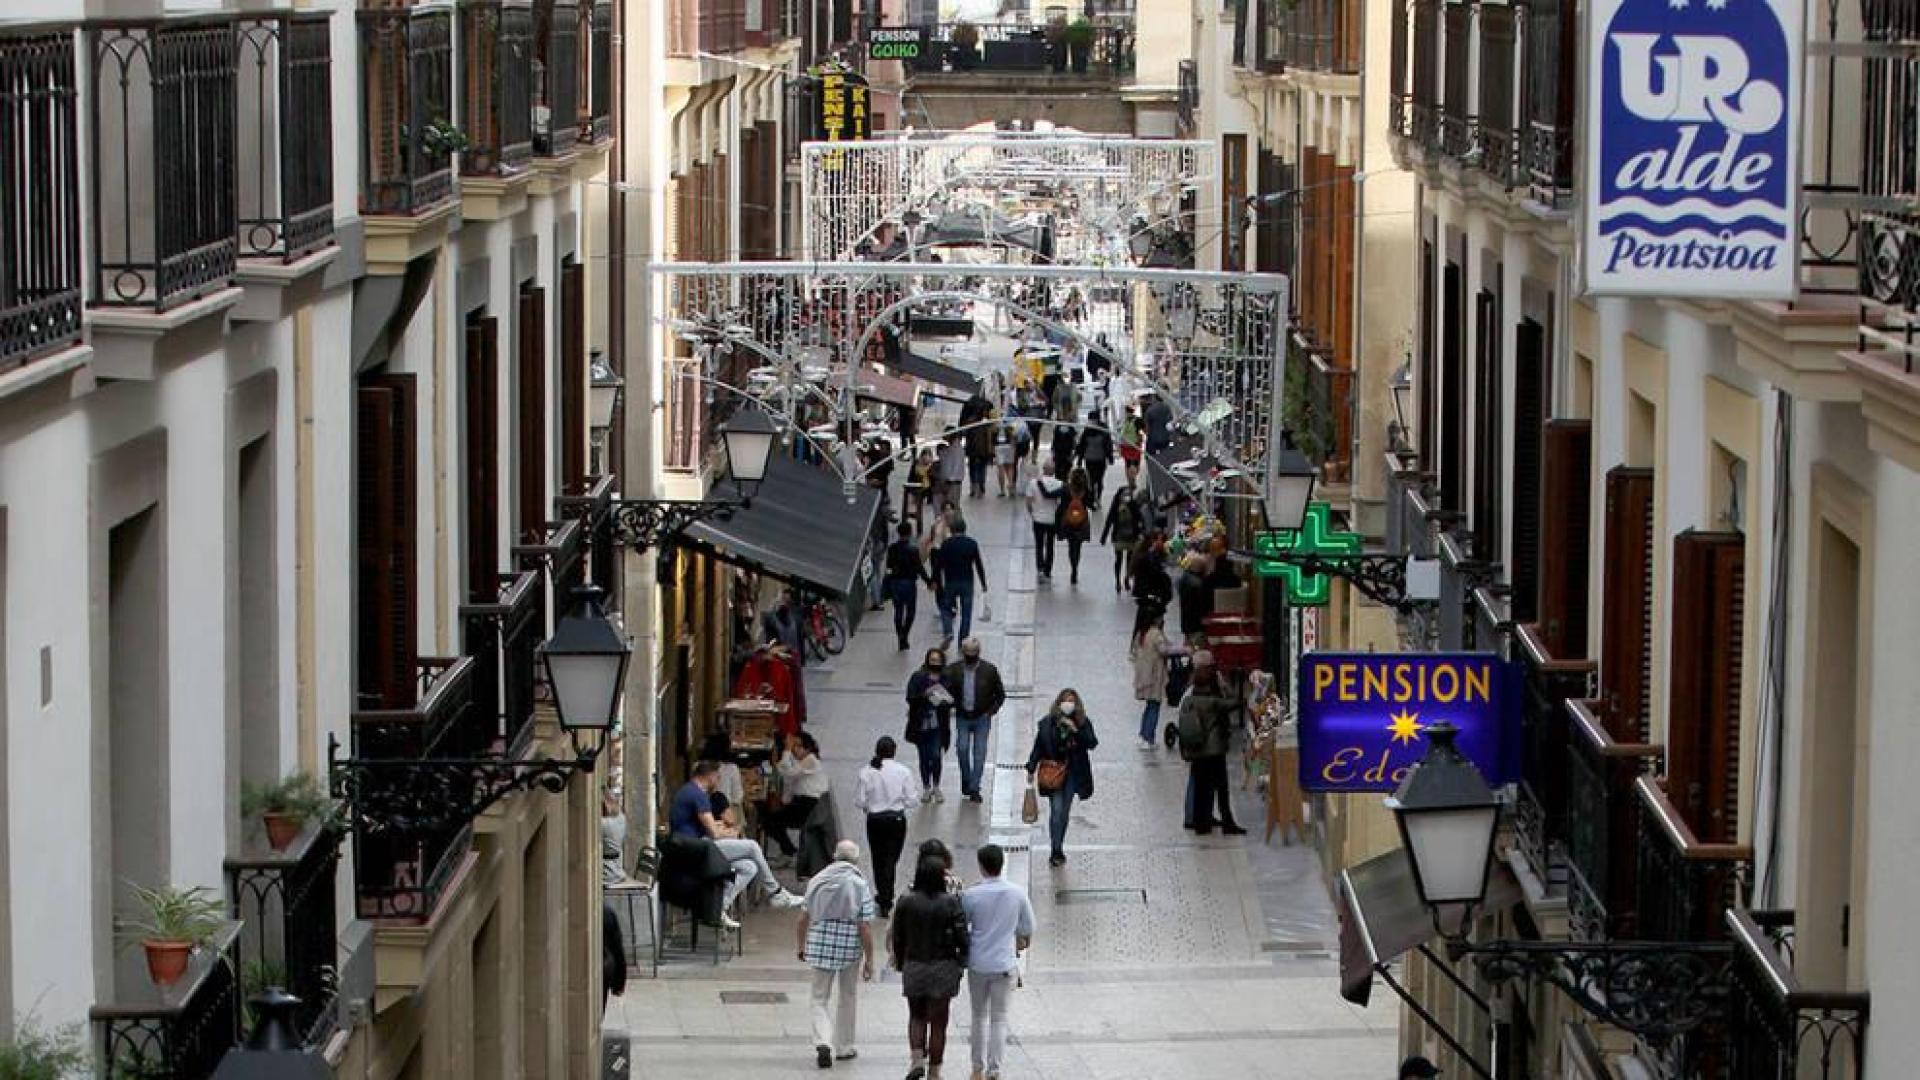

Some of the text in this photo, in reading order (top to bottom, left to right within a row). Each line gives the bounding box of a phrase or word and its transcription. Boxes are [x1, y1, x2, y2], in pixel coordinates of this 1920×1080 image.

[871, 30, 920, 42] PENSION
[872, 44, 919, 57] GOIKO
[1615, 124, 1773, 192] alde
[1603, 231, 1777, 275] Pentsioa
[1313, 663, 1491, 703] PENSION
